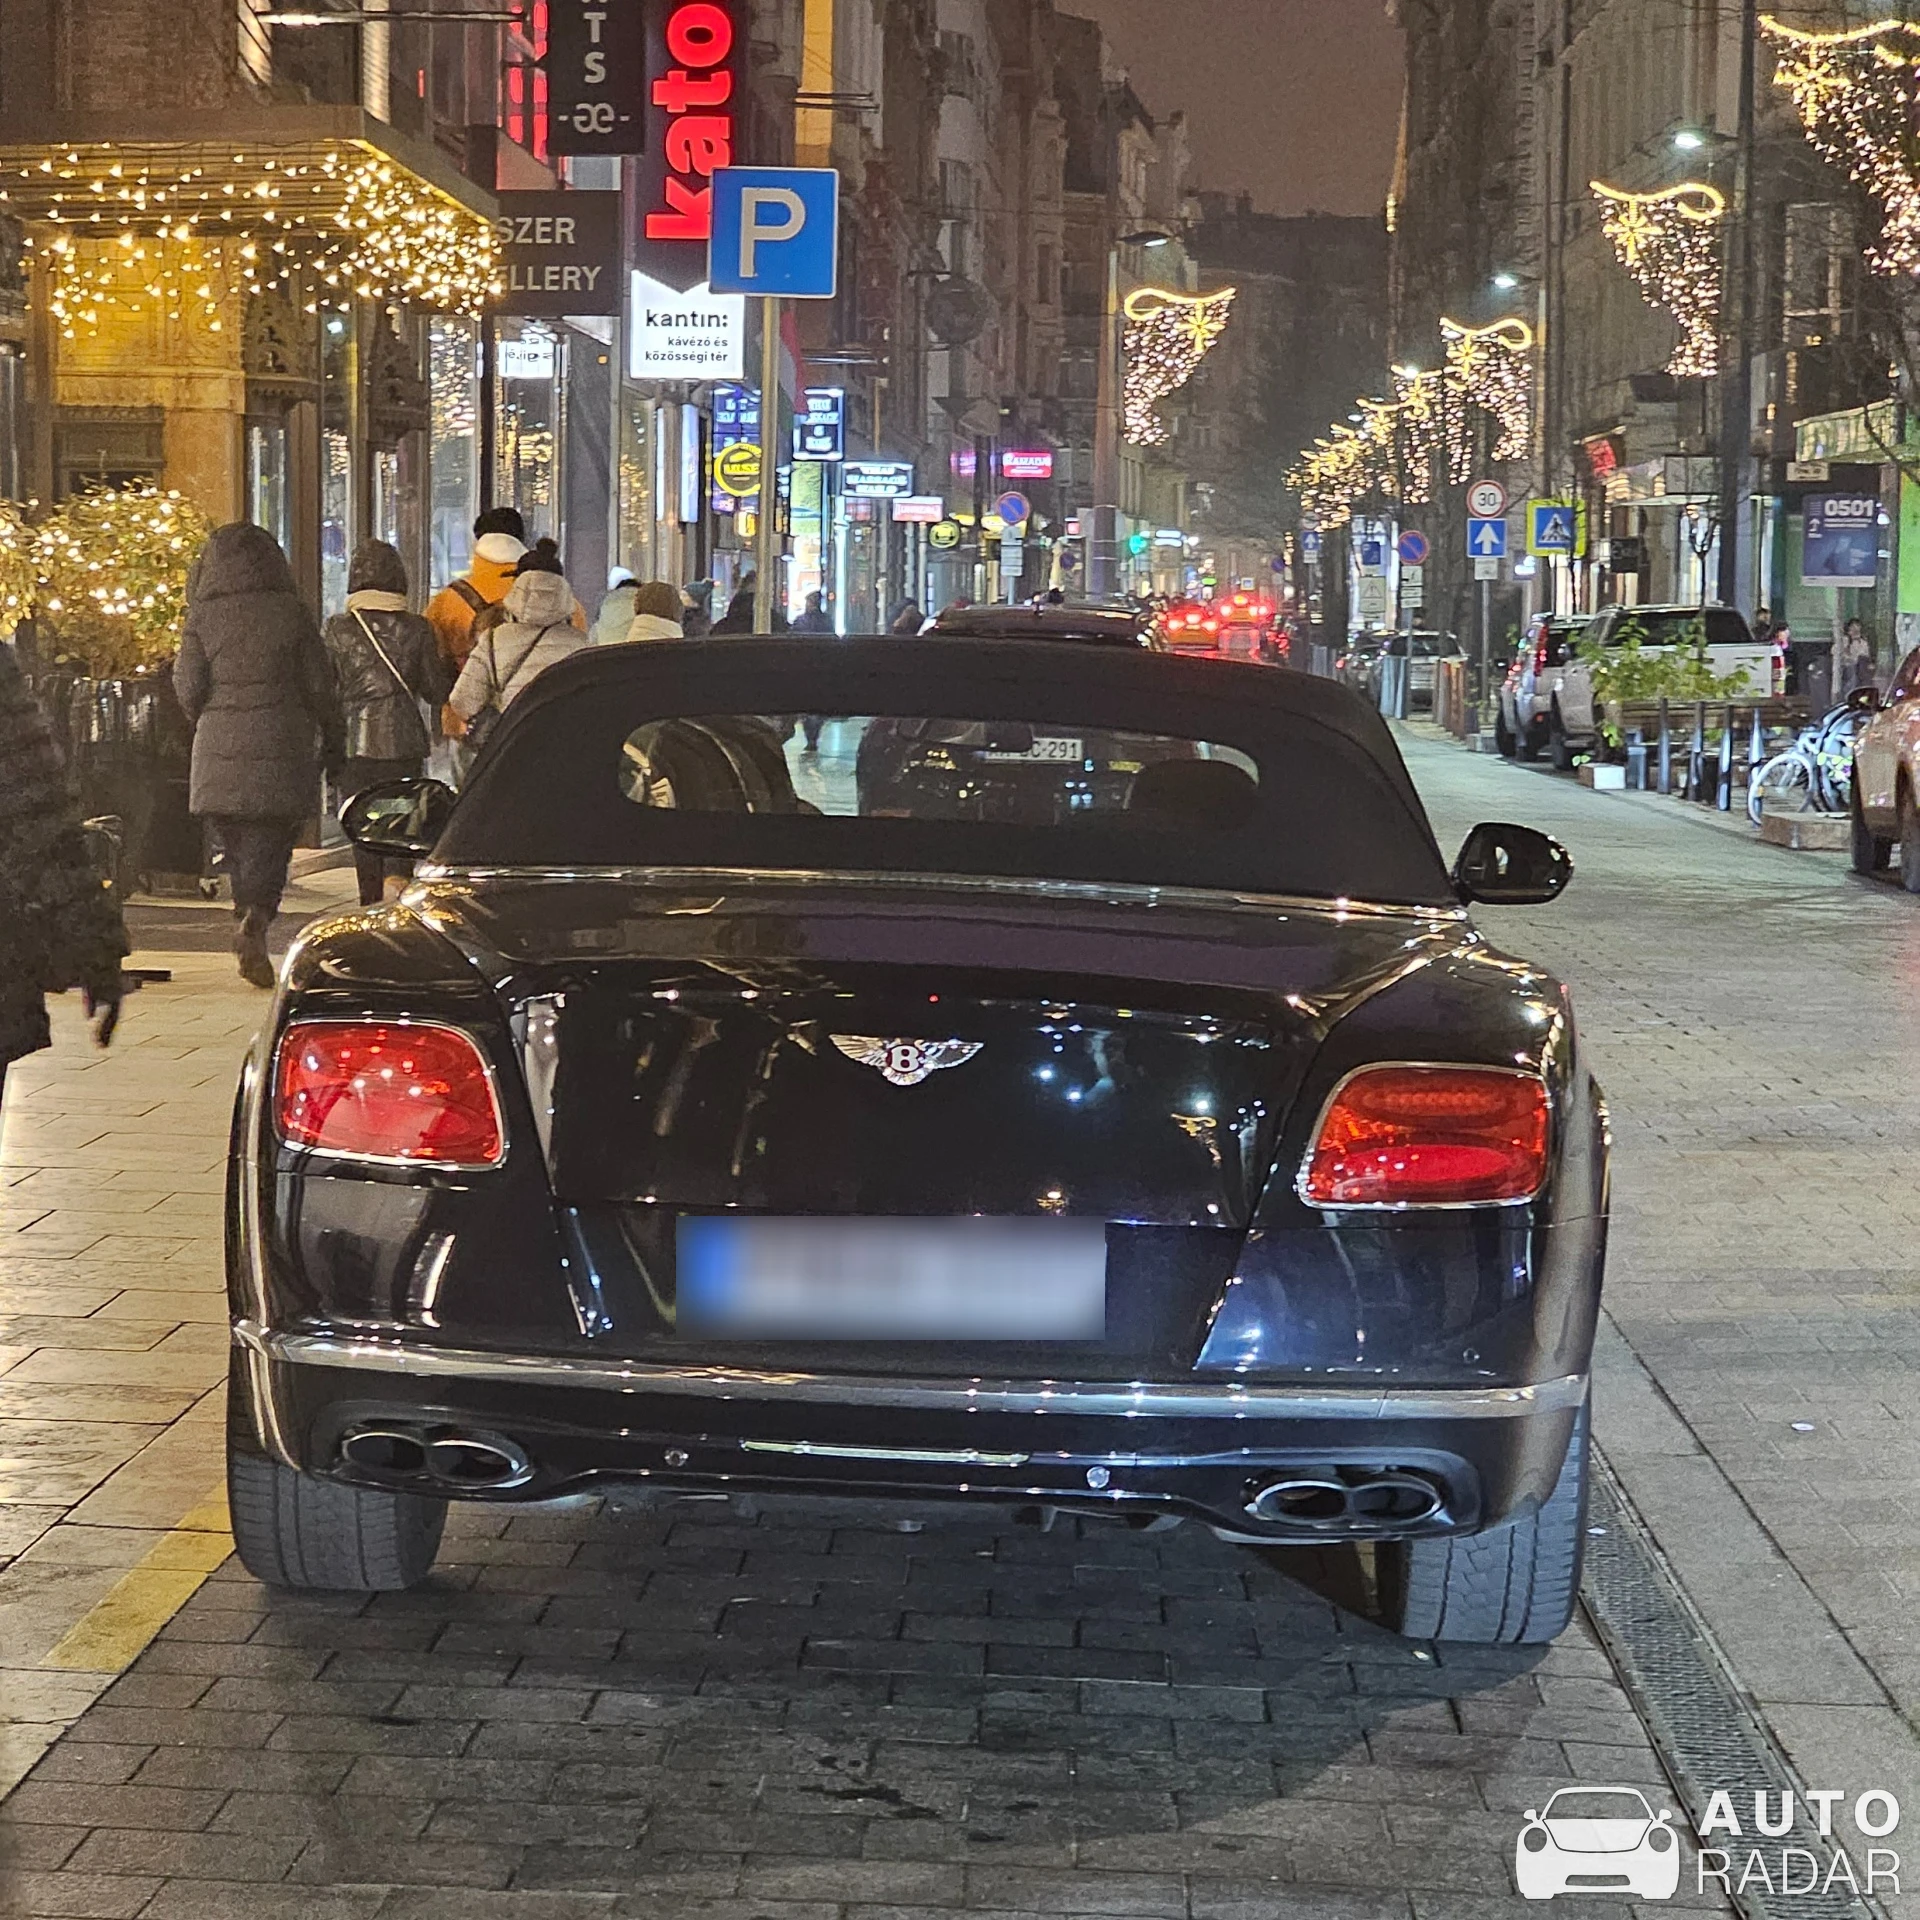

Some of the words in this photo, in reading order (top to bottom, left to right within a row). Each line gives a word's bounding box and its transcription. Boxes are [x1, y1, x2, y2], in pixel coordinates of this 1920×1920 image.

[582, 0, 607, 84] TS
[646, 3, 733, 240] kato
[738, 187, 806, 278] P
[667, 335, 710, 347] kávézó
[713, 336, 728, 347] és
[710, 351, 728, 362] tér
[1478, 493, 1496, 507] 30
[1824, 498, 1874, 517] 0501
[1020, 741, 1078, 759] C-291
[891, 1045, 920, 1072] B
